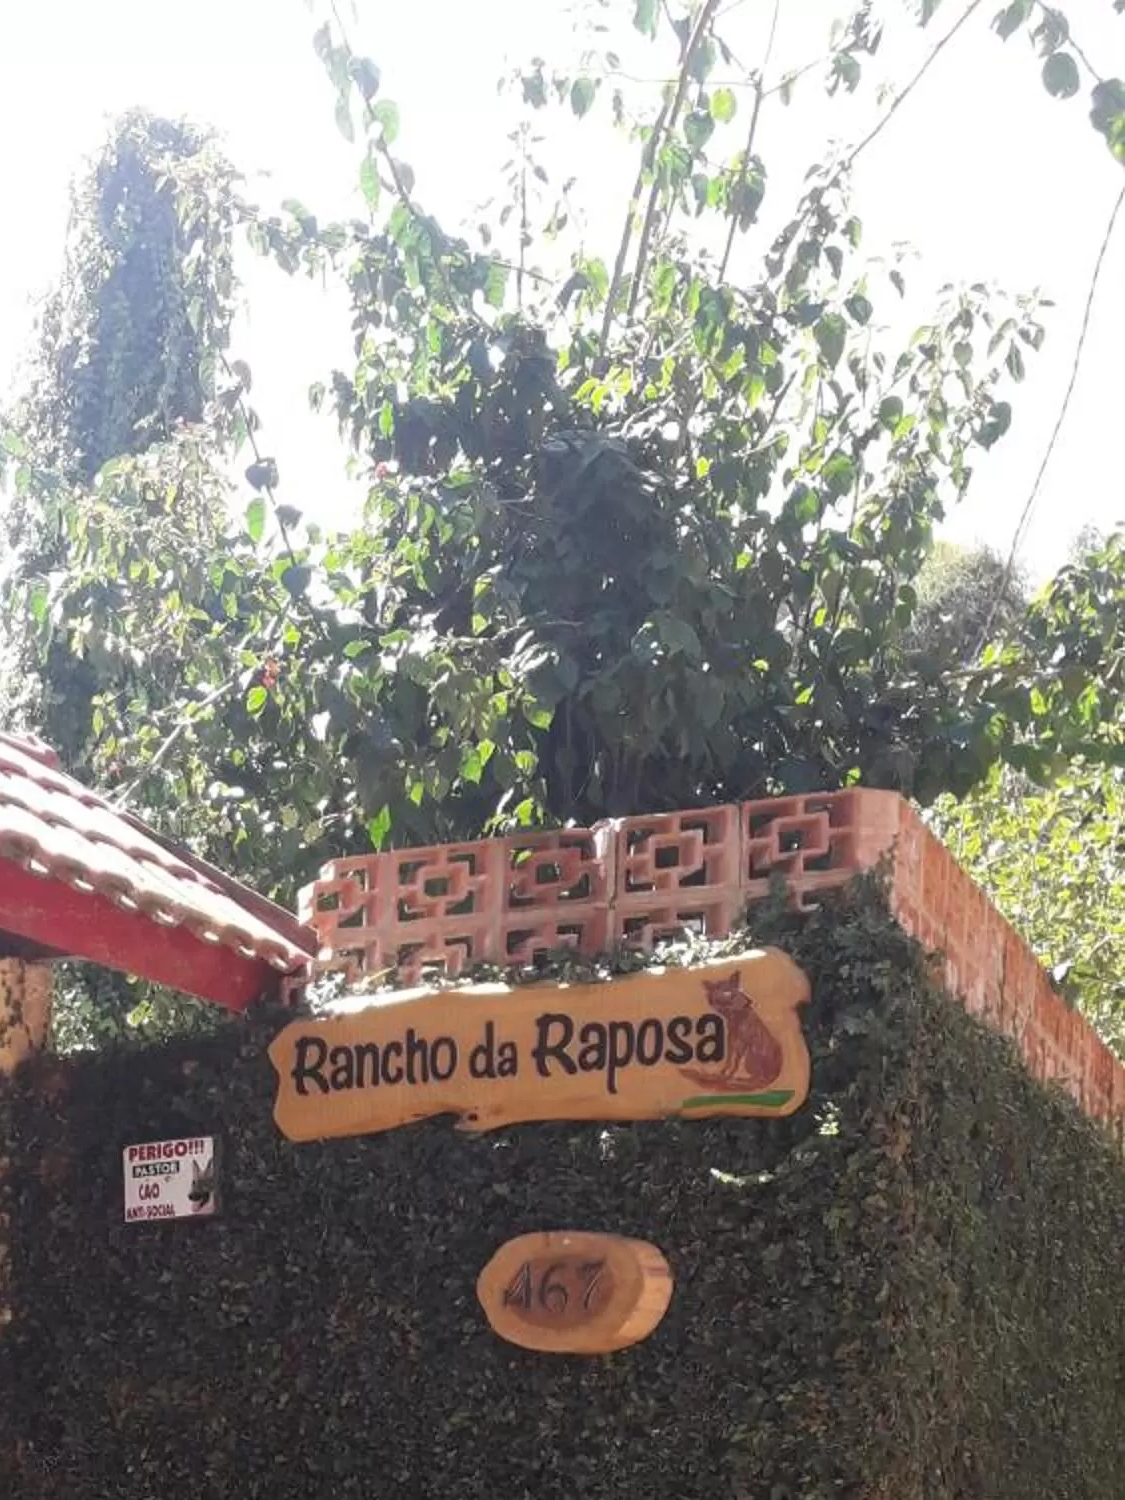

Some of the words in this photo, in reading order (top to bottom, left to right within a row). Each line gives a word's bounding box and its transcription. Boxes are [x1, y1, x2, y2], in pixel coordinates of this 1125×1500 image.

[291, 1028, 458, 1096] Rancho
[469, 1020, 518, 1079] da
[531, 1013, 725, 1094] Raposa
[128, 1140, 205, 1162] PERIGO!!!
[135, 1161, 179, 1177] PASTOR
[502, 1256, 609, 1316] 467
